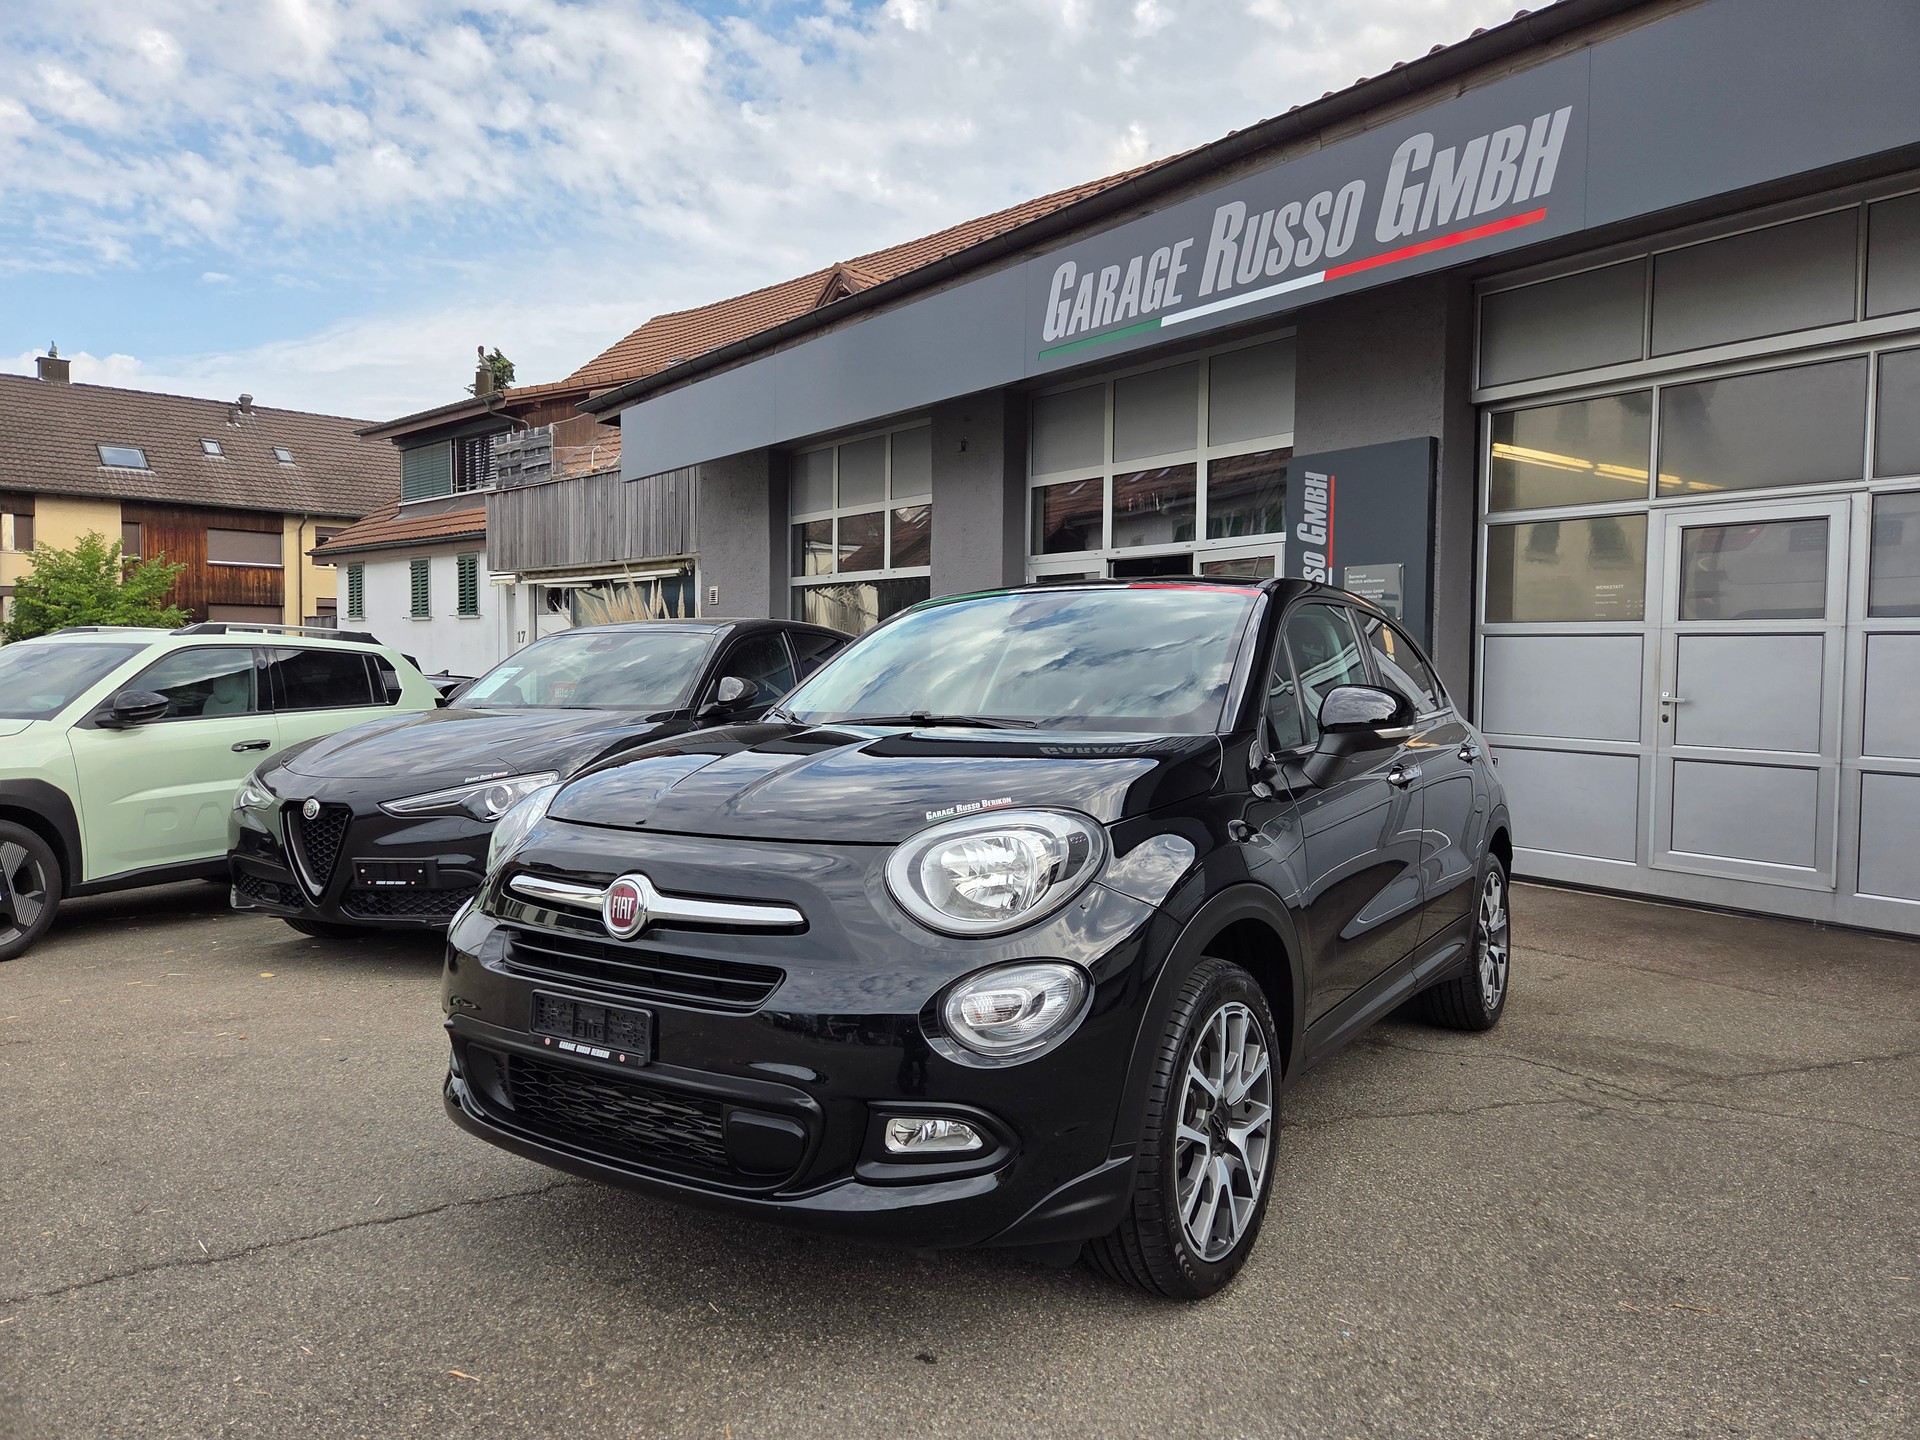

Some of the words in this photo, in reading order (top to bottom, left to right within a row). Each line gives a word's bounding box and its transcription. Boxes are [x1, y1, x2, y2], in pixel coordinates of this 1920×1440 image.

[1042, 237, 1194, 342] GARAGE
[1198, 179, 1366, 297] RUSSO
[1303, 550, 1326, 584] SO
[517, 630, 526, 643] 17
[925, 807, 955, 820] GARAGE
[956, 802, 981, 813] RUSSO
[612, 895, 635, 920] FIAT
